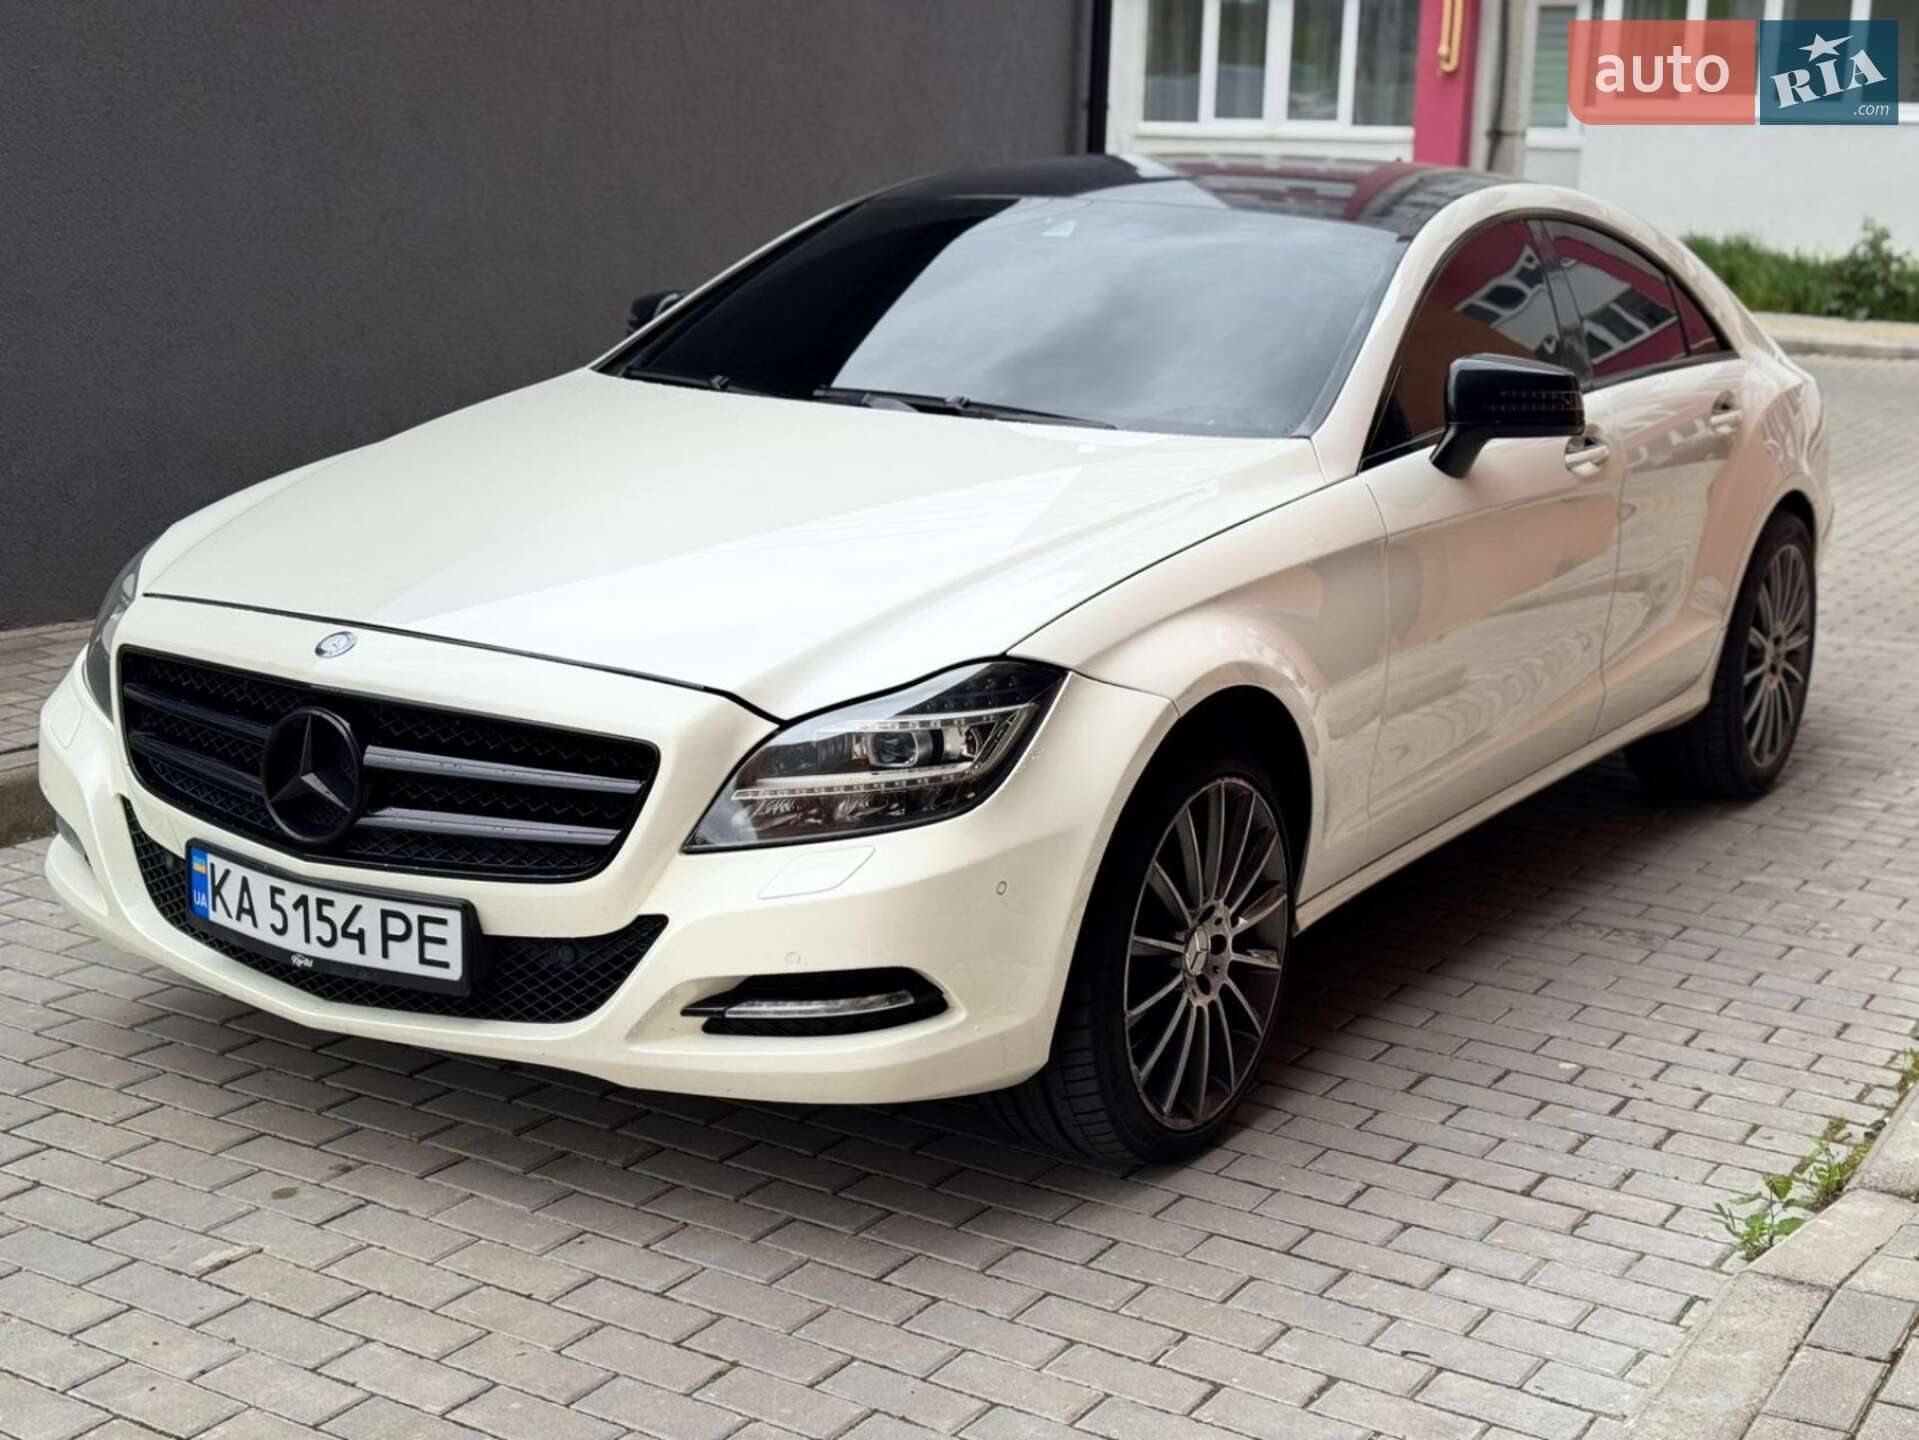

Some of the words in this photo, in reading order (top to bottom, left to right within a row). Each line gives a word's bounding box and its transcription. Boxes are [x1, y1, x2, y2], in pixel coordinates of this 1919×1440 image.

[192, 889, 208, 909] UA
[210, 862, 259, 929] KA
[269, 884, 366, 956] 5154
[380, 907, 451, 970] PE
